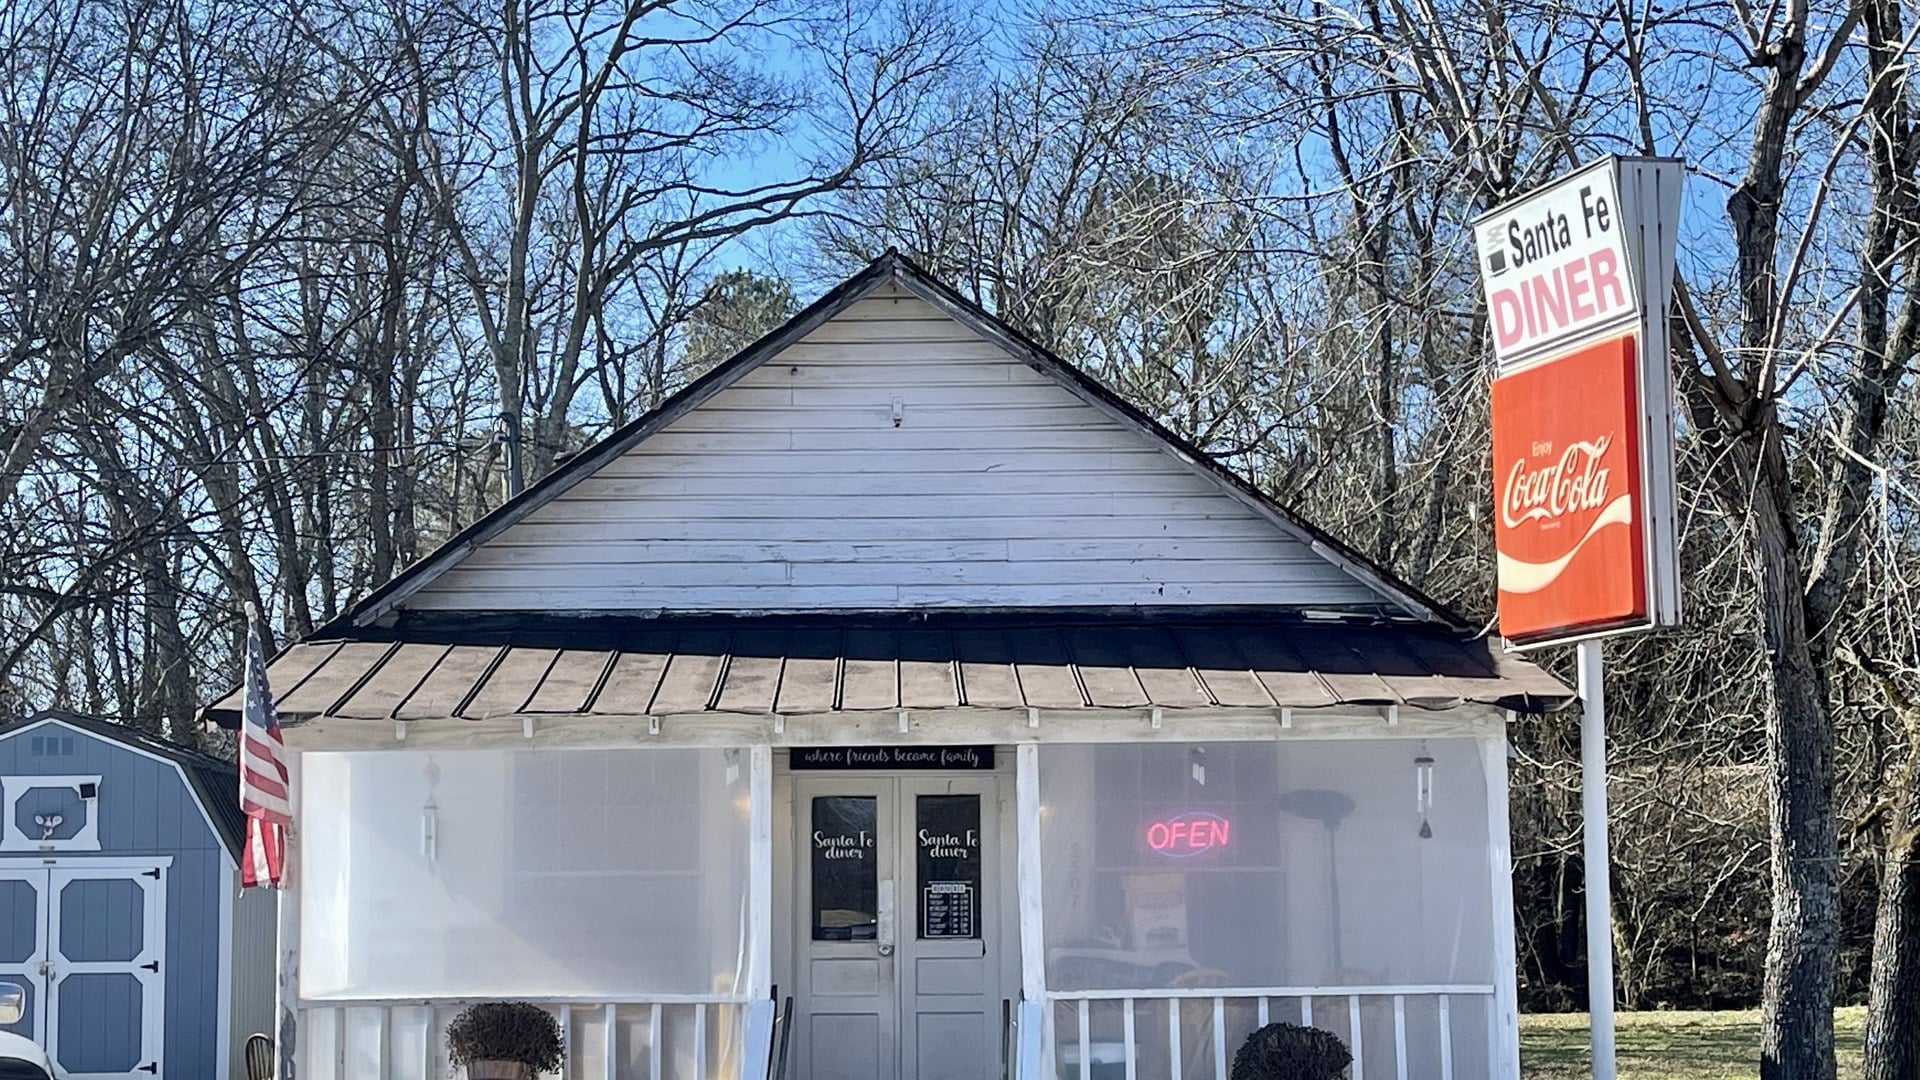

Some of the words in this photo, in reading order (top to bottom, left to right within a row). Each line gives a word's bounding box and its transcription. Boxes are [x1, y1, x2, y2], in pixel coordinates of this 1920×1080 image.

[1508, 208, 1572, 269] Santa
[1580, 185, 1611, 239] Fe
[1491, 247, 1626, 349] DINER
[1531, 440, 1553, 457] Enjoy
[1502, 430, 1614, 529] Coca-Cola
[805, 748, 843, 762] where
[846, 748, 890, 766] friends
[894, 748, 937, 762] become
[940, 748, 980, 768] family
[813, 830, 857, 849] Santa
[859, 830, 874, 848] Fe
[918, 828, 961, 849] Santa
[965, 829, 978, 848] Fe
[825, 846, 865, 859] diner
[929, 845, 969, 859] diner
